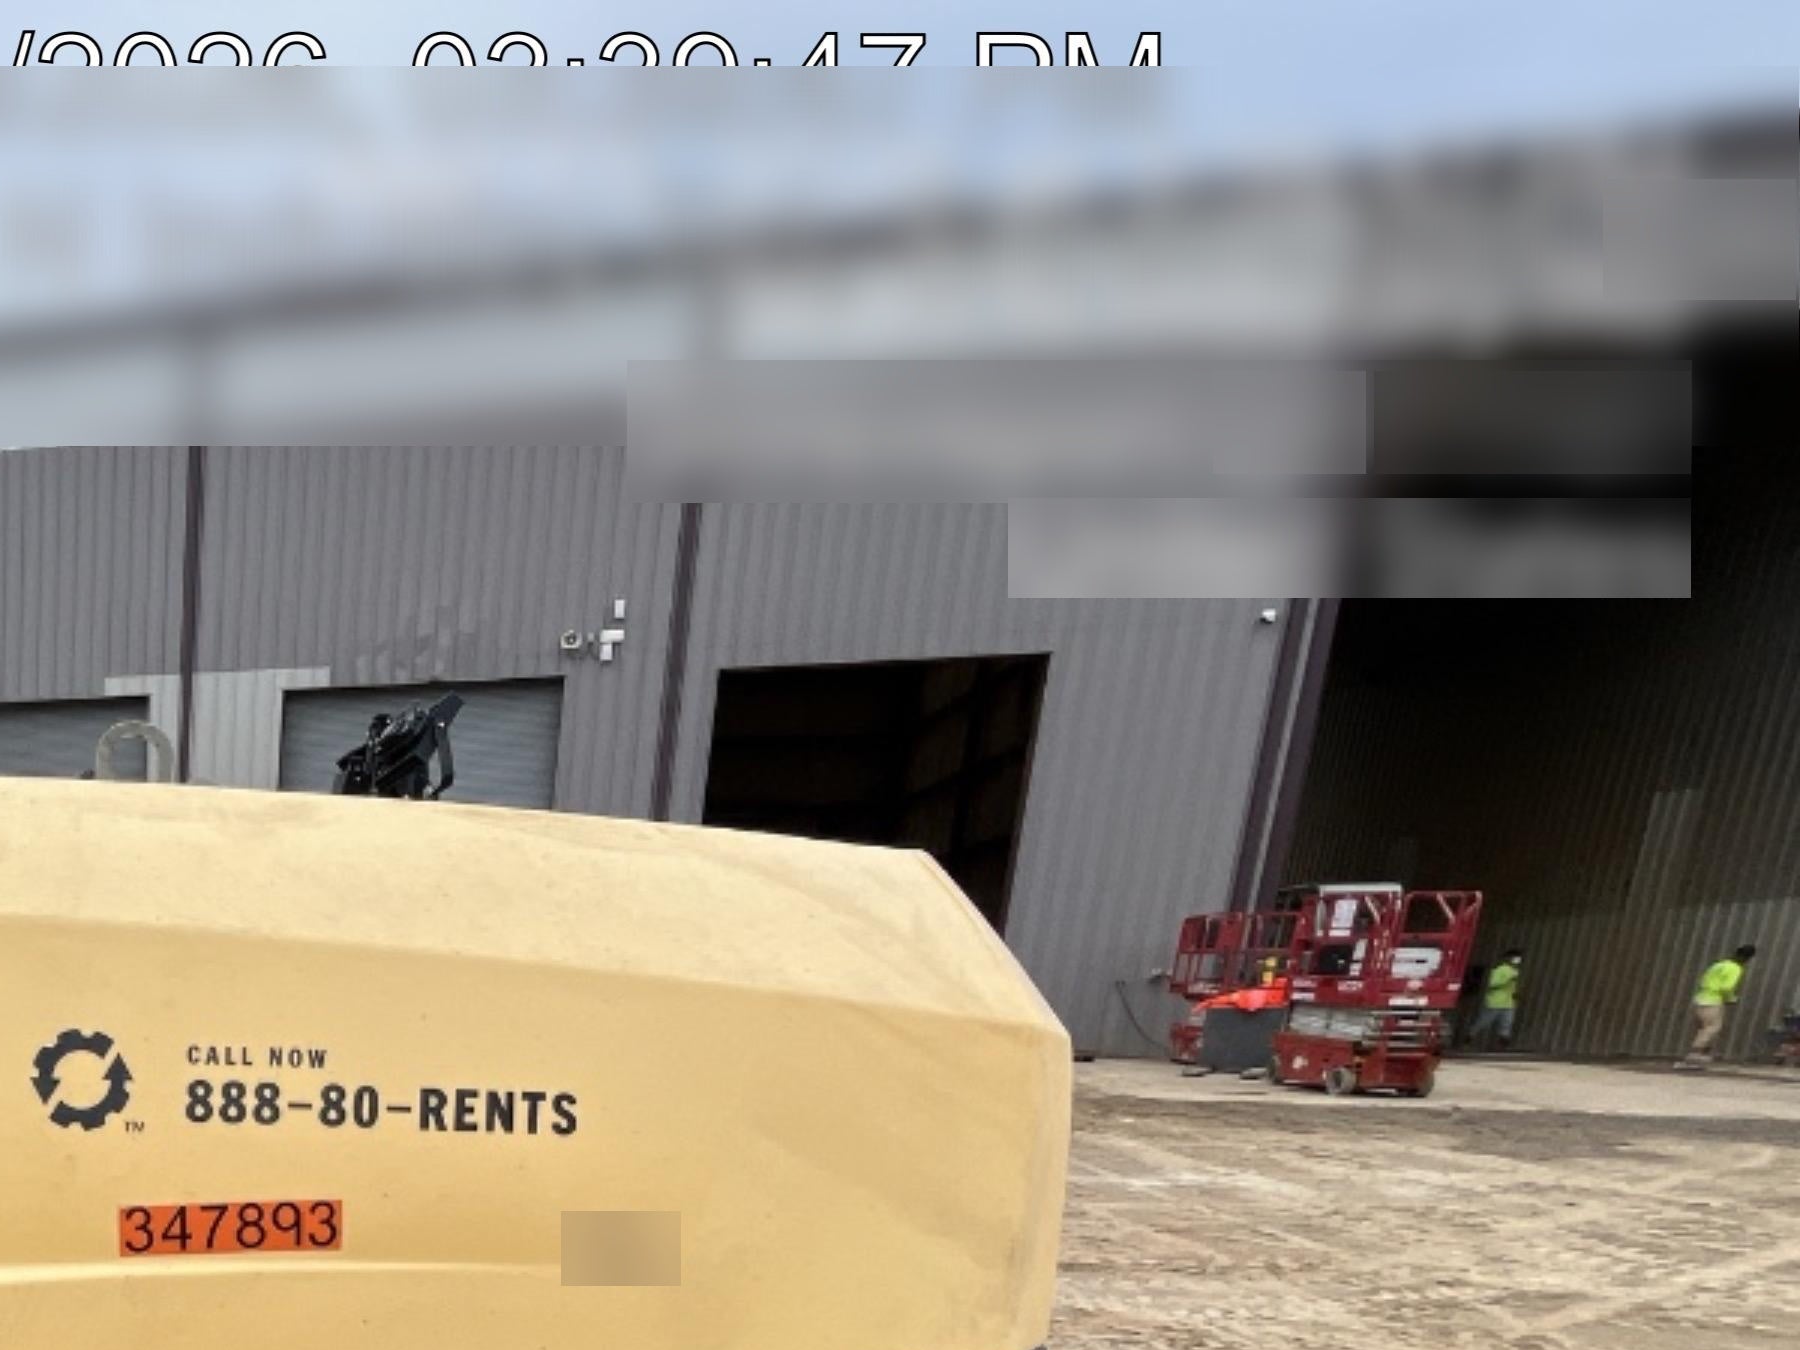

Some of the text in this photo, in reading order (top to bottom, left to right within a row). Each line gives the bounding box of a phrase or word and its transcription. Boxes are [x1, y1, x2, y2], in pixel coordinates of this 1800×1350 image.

[187, 1046, 328, 1069] CALL NOW
[185, 1079, 578, 1136] 888-80-RENTS
[124, 1201, 338, 1254] 347893
